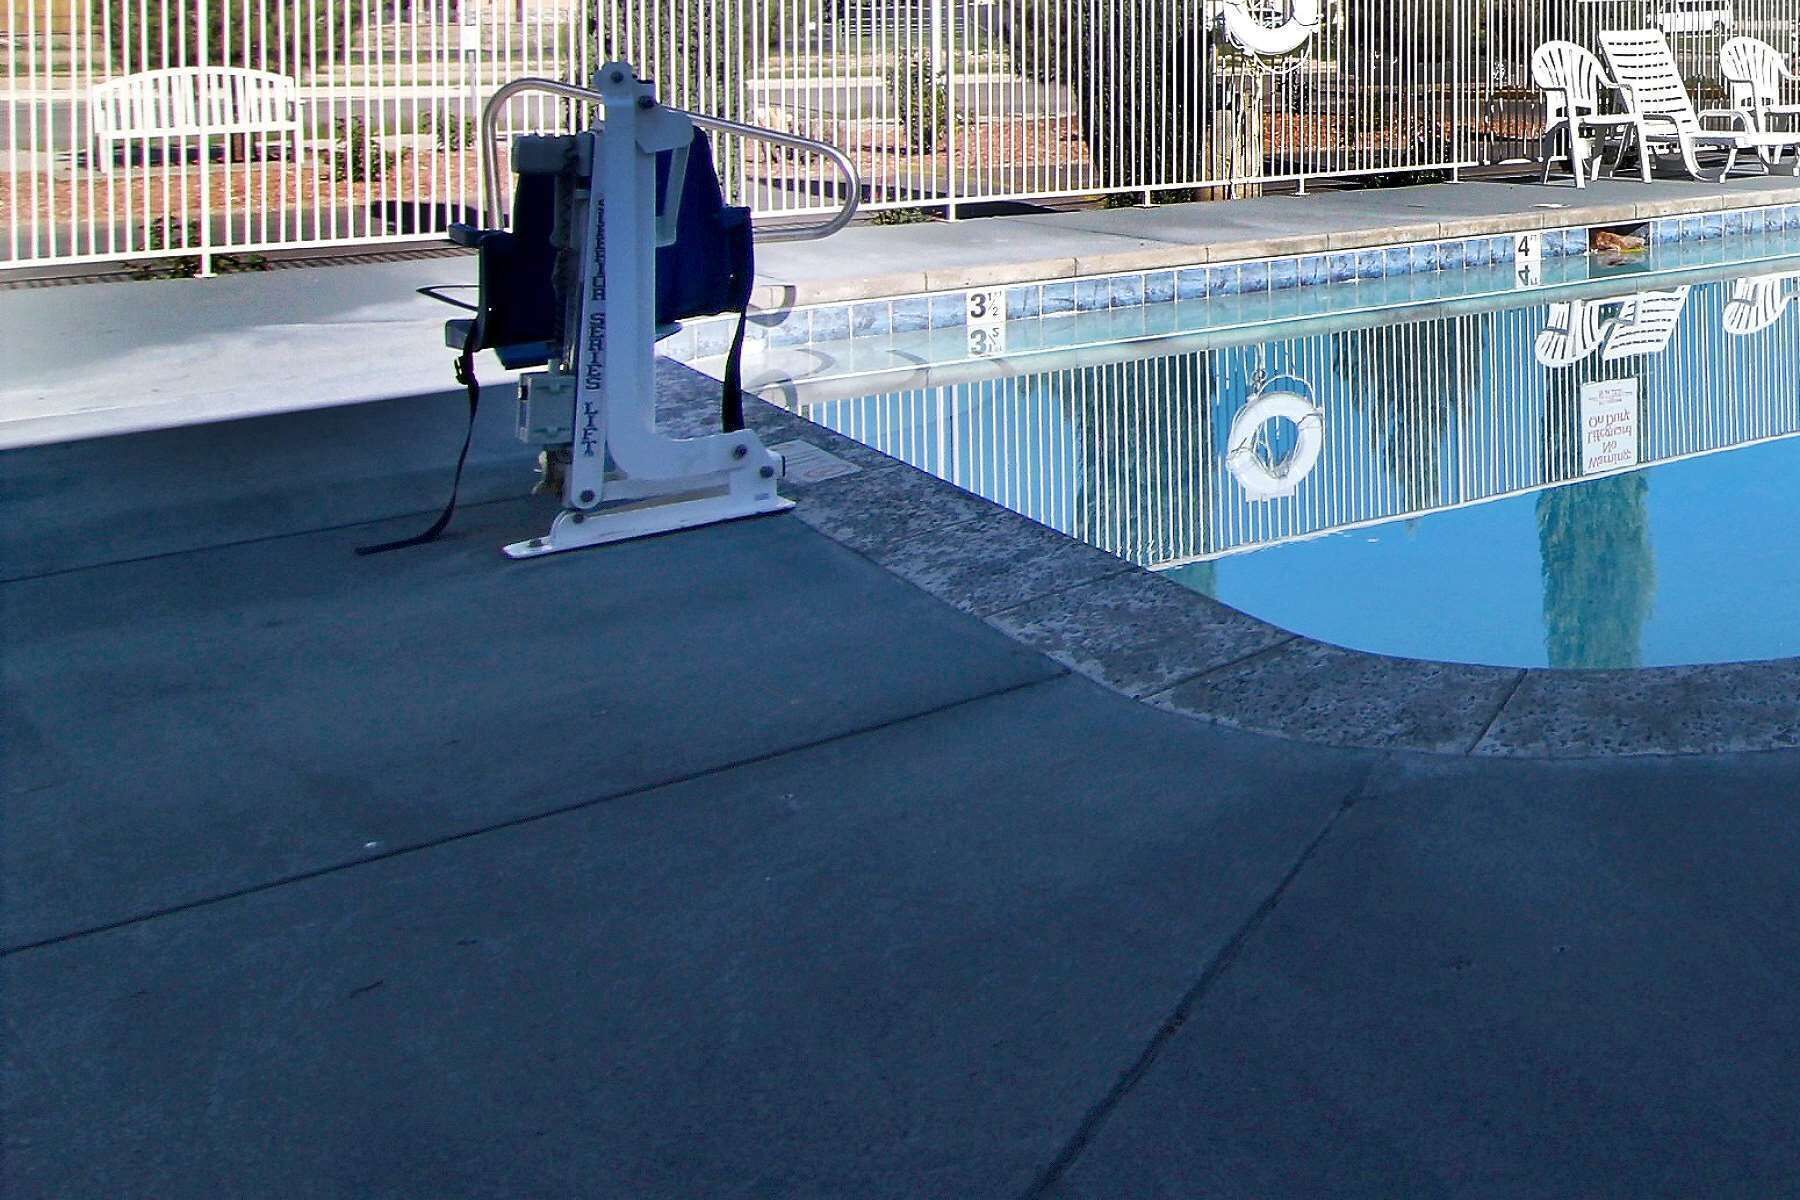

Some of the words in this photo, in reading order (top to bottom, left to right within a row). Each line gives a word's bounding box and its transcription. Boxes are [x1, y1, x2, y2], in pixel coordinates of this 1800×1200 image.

[1518, 236, 1530, 257] 4
[585, 312, 606, 390] SERIES
[582, 401, 600, 457] LIFT
